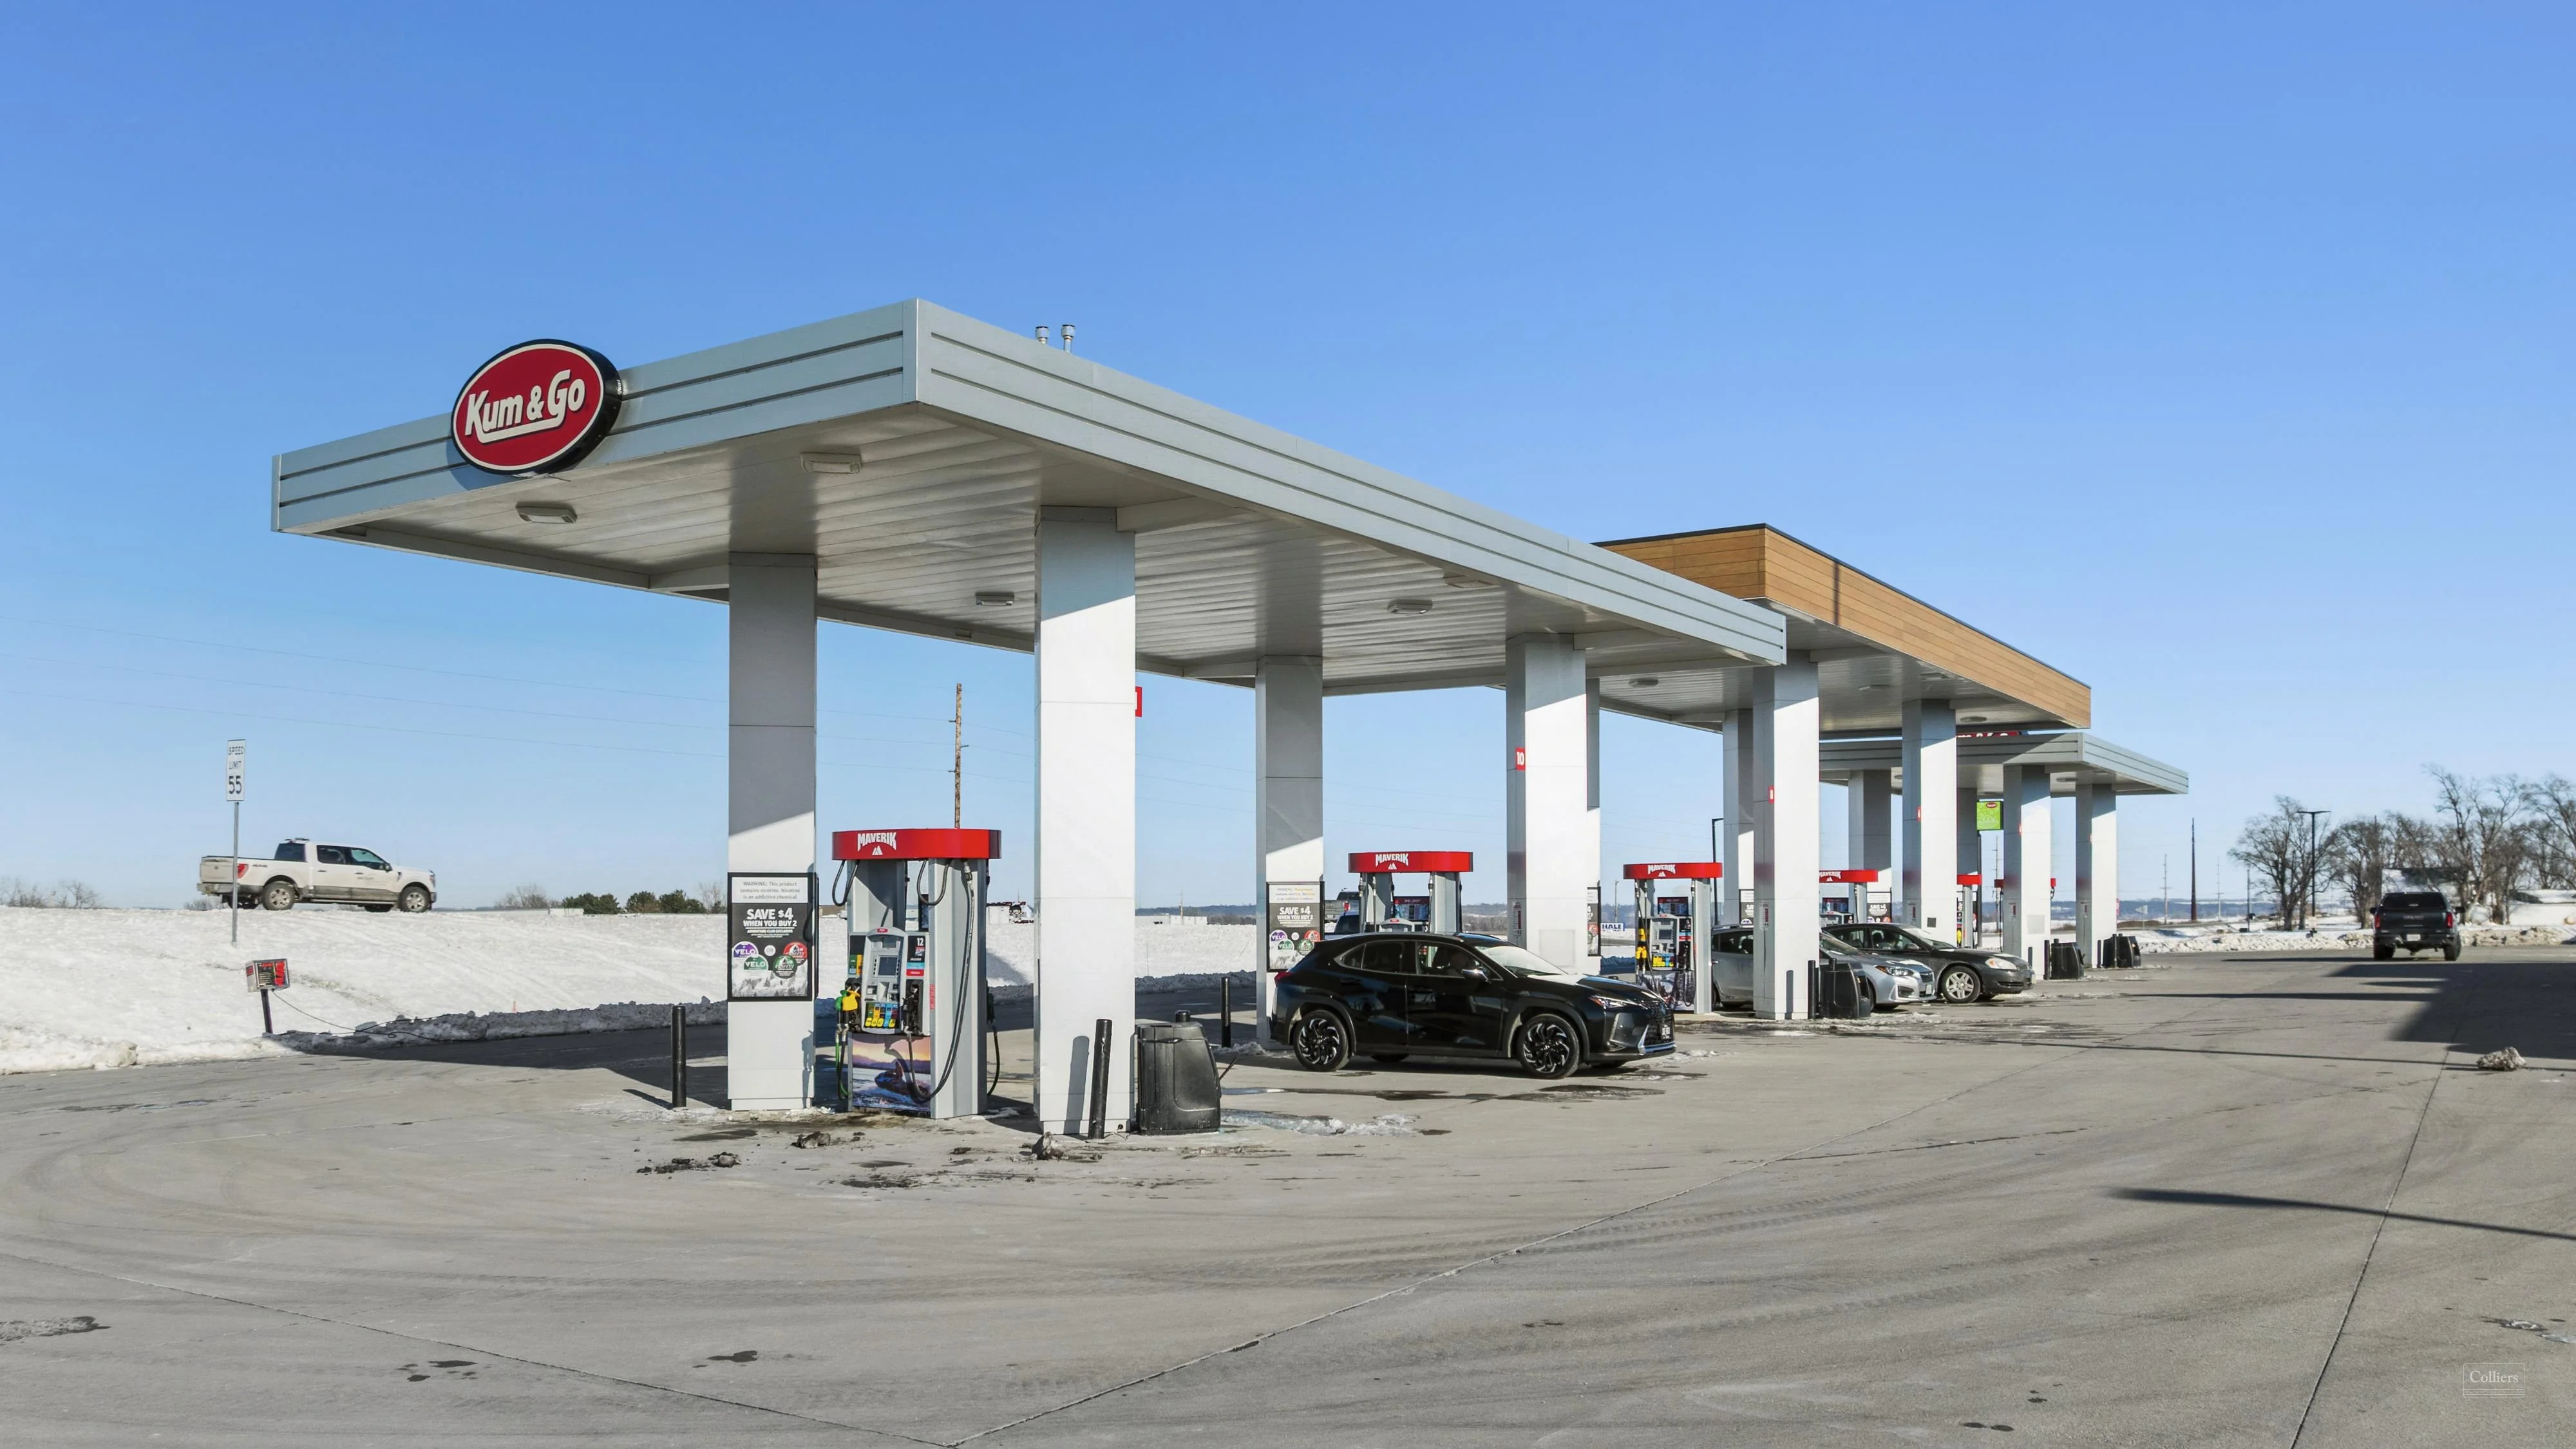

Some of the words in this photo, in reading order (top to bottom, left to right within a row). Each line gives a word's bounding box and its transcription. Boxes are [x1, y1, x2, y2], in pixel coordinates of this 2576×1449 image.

[464, 390, 524, 440] Kum
[526, 385, 545, 421] &
[547, 369, 585, 428] Go
[229, 746, 243, 755] SPEED
[229, 761, 242, 770] LIMIT
[1517, 752, 1524, 766] 10
[229, 775, 242, 795] 55
[857, 832, 896, 852] MAVERIK
[1375, 853, 1408, 867] MAVERIK
[1647, 864, 1676, 875] MAVERIK
[747, 909, 775, 920] SAVE
[778, 907, 793, 920] $4
[916, 938, 924, 946] 12
